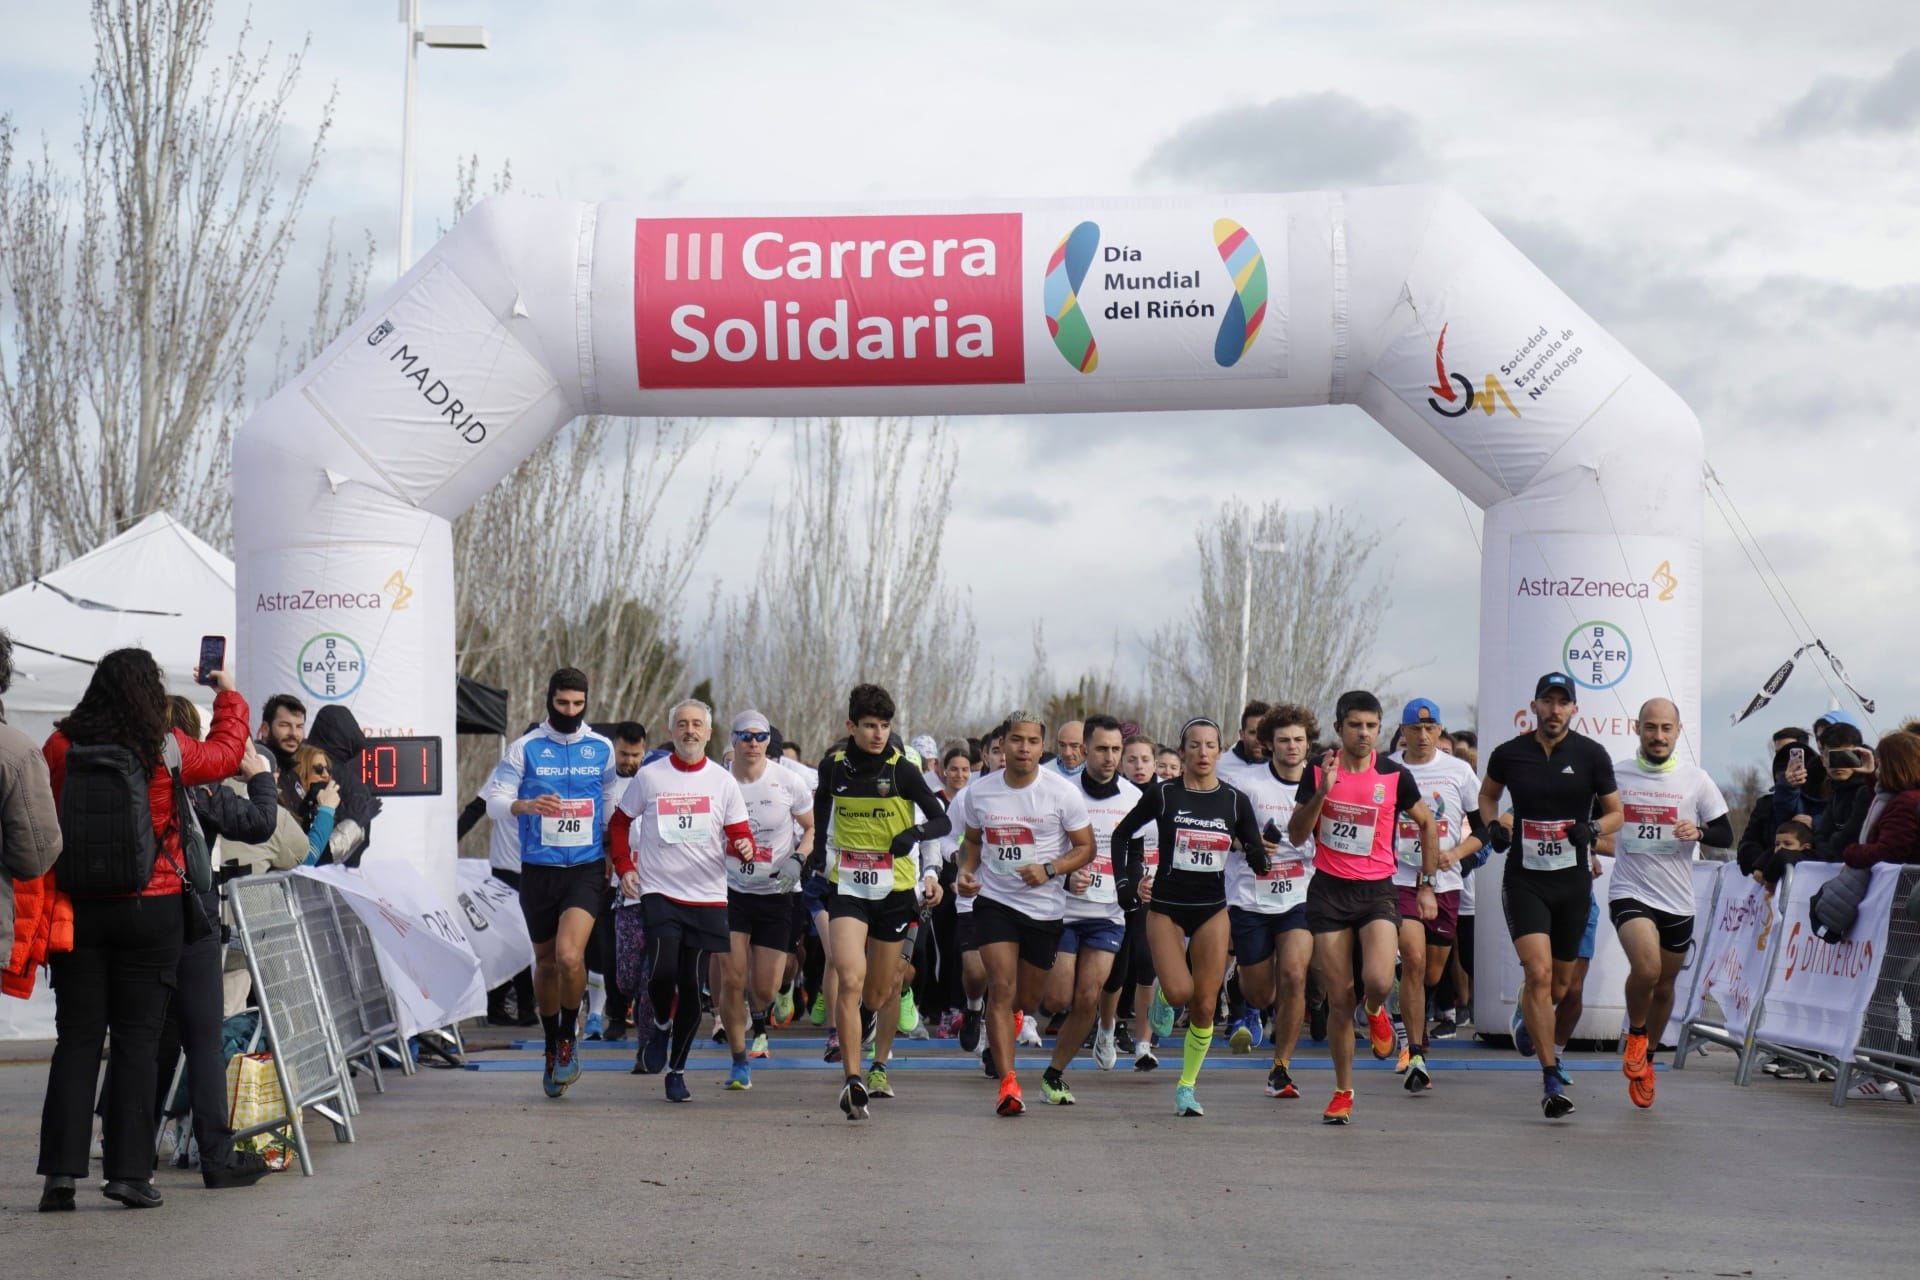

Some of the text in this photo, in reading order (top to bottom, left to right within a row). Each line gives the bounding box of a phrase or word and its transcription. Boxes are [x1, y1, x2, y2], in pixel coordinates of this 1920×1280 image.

[664, 232, 996, 280] III Carrera
[1104, 246, 1142, 263] Día
[1104, 270, 1200, 290] Mundial
[1104, 300, 1215, 319] del Riñón
[670, 299, 994, 362] Solidaria
[1500, 326, 1549, 376] Sociedad
[1514, 328, 1575, 388] Española de
[1528, 346, 1583, 400] Nefrología
[390, 344, 486, 444] MADRID
[1517, 576, 1649, 598] AstraZeneca
[256, 590, 381, 612] AstraZeneca
[1569, 649, 1626, 661] BAYER
[1592, 627, 1604, 684] BAYER
[303, 661, 359, 672] BAYER
[325, 639, 336, 695] BAYER
[536, 766, 600, 776] GERUNNERS
[557, 819, 581, 833] 246
[678, 816, 693, 829] 37
[1332, 822, 1358, 839] 224
[1638, 824, 1662, 839] 231
[998, 846, 1021, 861] 249
[1537, 842, 1562, 857] 345
[1190, 851, 1213, 866] 316
[853, 870, 879, 885] 380
[1271, 880, 1292, 894] 285
